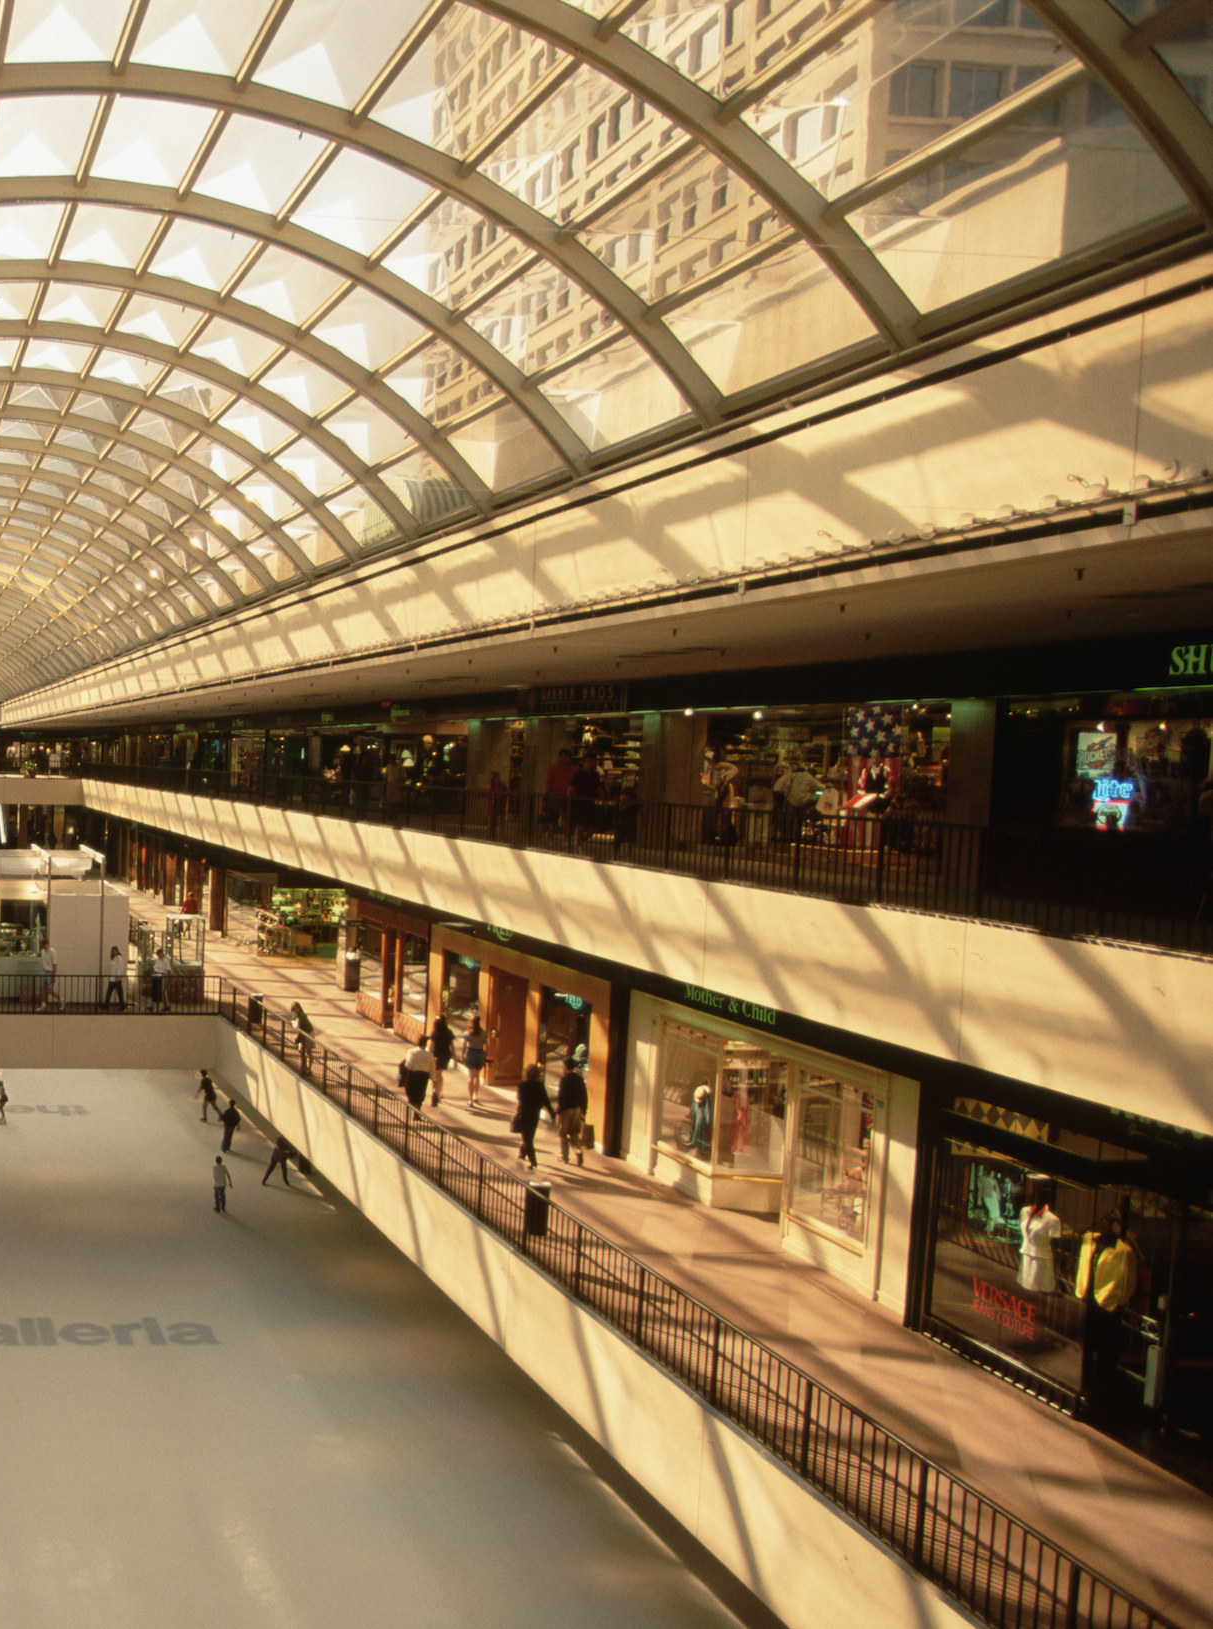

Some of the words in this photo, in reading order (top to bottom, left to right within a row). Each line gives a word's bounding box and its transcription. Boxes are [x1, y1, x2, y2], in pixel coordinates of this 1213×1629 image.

[1092, 777, 1134, 802] Lite
[684, 983, 725, 1008] Mother
[727, 997, 739, 1014] &
[741, 1000, 776, 1026] Child
[971, 1299, 995, 1321] JEANS
[997, 1311, 1035, 1342] COUTURE
[972, 1276, 1038, 1325] VERSACE
